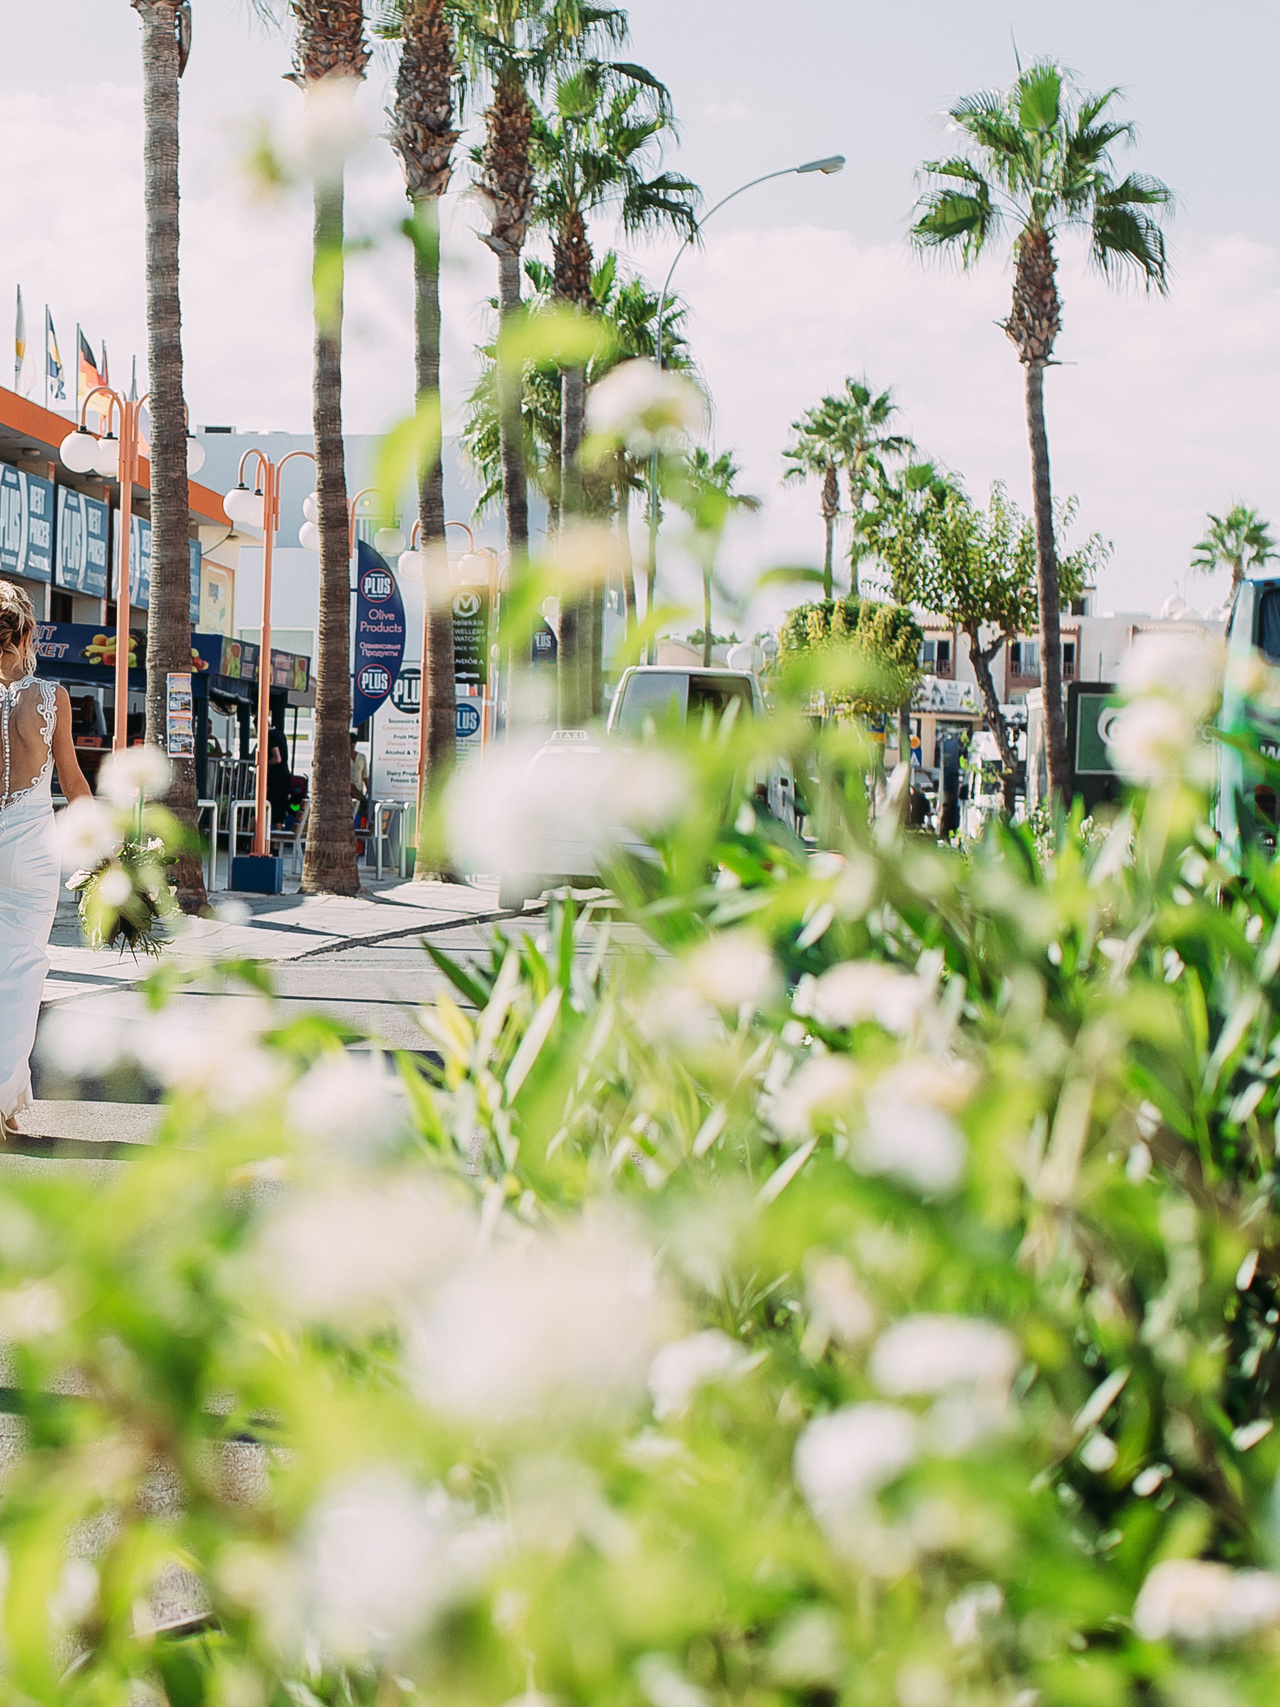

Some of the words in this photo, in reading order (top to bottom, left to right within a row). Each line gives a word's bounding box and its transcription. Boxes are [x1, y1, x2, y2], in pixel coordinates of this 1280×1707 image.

[364, 577, 391, 594] PLUS
[368, 608, 395, 620] Olive
[360, 621, 402, 633] Products
[362, 649, 398, 658] Продукты
[361, 673, 388, 689] PLUS
[392, 679, 420, 703] PLU
[456, 711, 477, 729] LUS
